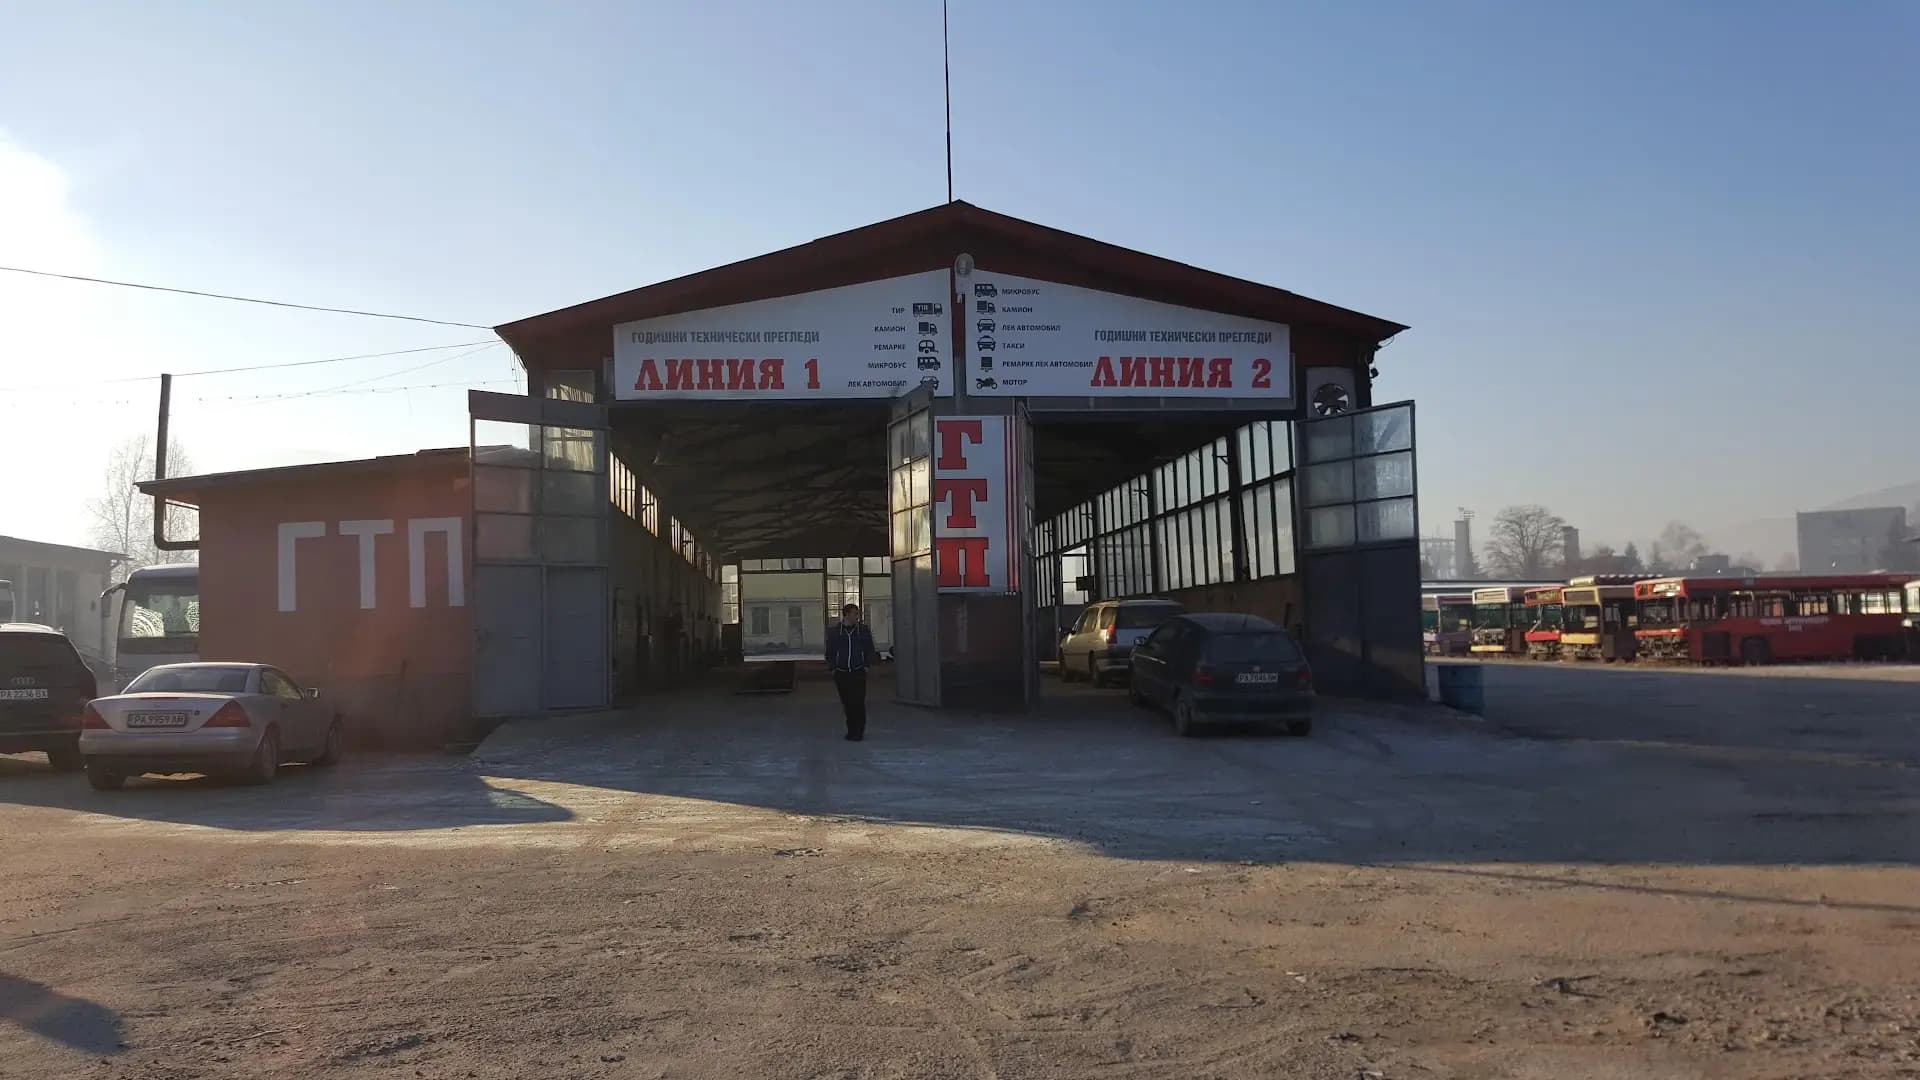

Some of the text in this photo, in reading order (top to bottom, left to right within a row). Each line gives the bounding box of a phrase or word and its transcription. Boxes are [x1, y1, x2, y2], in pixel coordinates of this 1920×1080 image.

[632, 331, 820, 344] ГОДИШНИ ТЕХНИЧЕСКИ ПРЕГЛЕДИ
[1095, 330, 1272, 344] ГОДИШНИ ТЕХНИЧЕСКИ ПРЕГЛЕДИ
[634, 358, 820, 390] ЛИНИЯ 1
[1090, 357, 1271, 388] ЛИНИЯ 2
[936, 420, 990, 587] ГТП
[278, 517, 464, 611] ГТП
